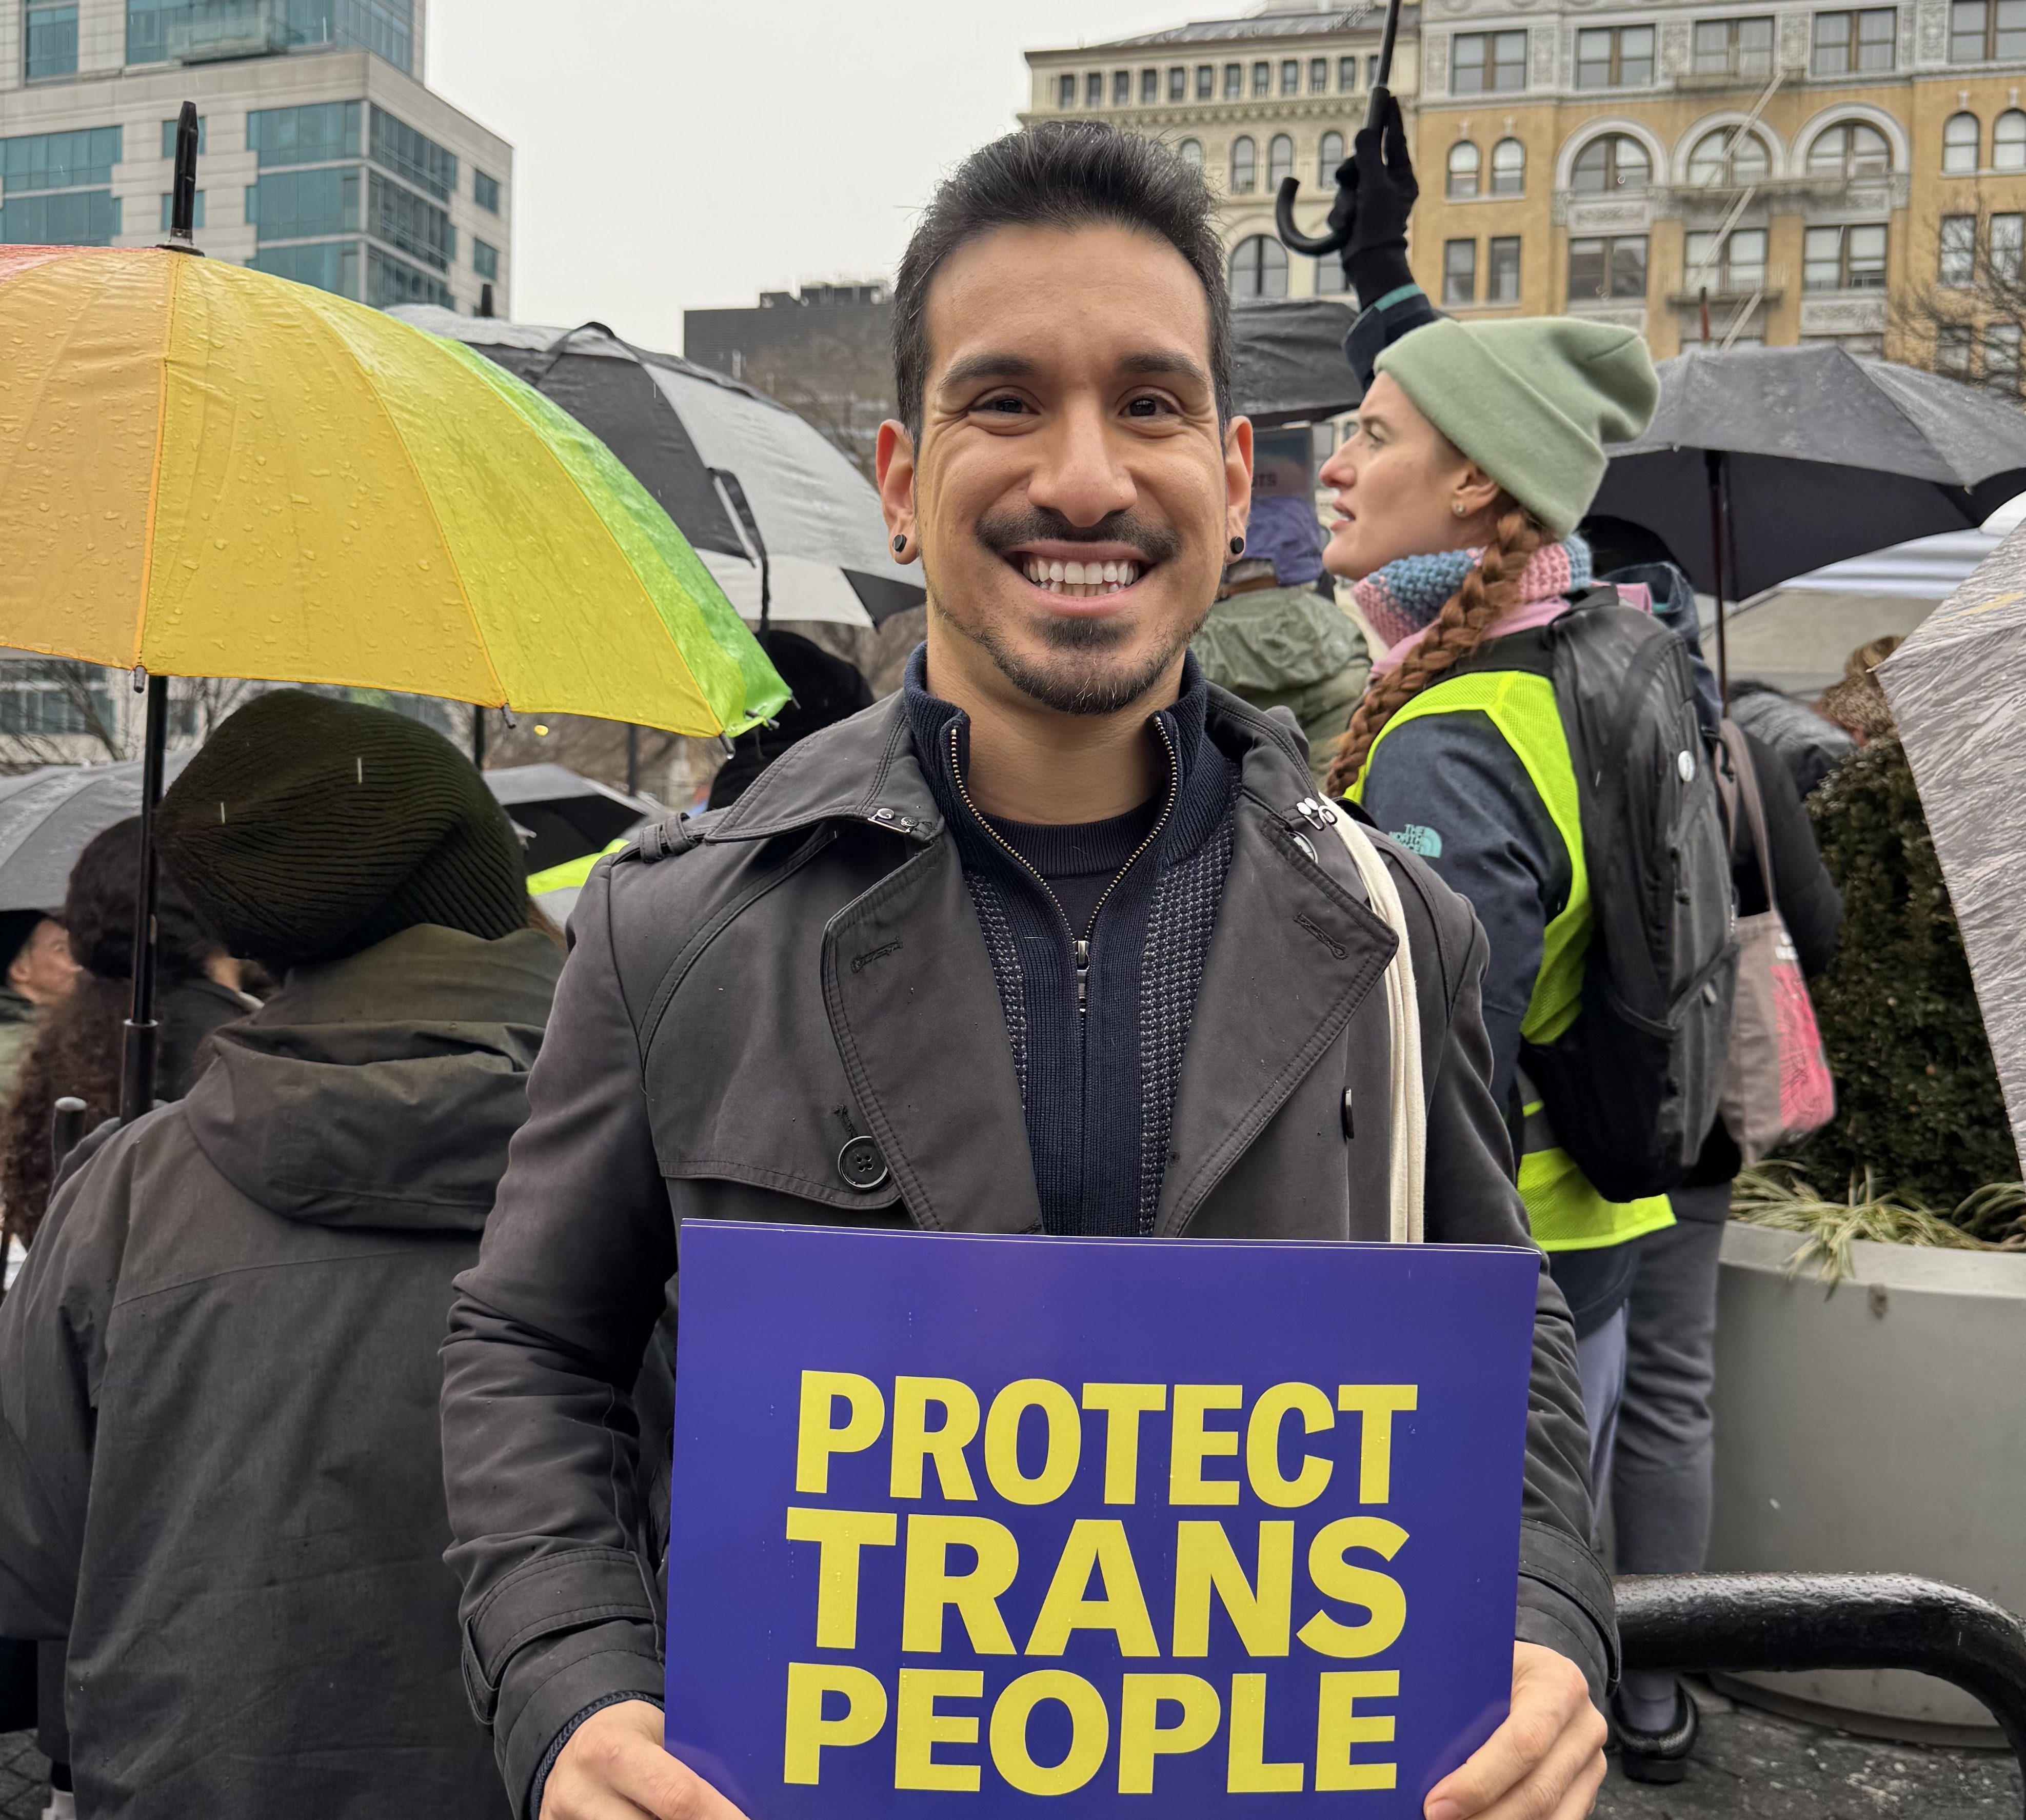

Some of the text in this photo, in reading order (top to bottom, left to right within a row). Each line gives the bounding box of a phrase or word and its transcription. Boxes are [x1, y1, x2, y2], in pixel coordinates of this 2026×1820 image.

[1404, 824, 1424, 835] THE
[796, 1372, 1417, 1508] PROTECT
[787, 1508, 1408, 1658] TRANS
[784, 1664, 1399, 1796] PEOPLE
